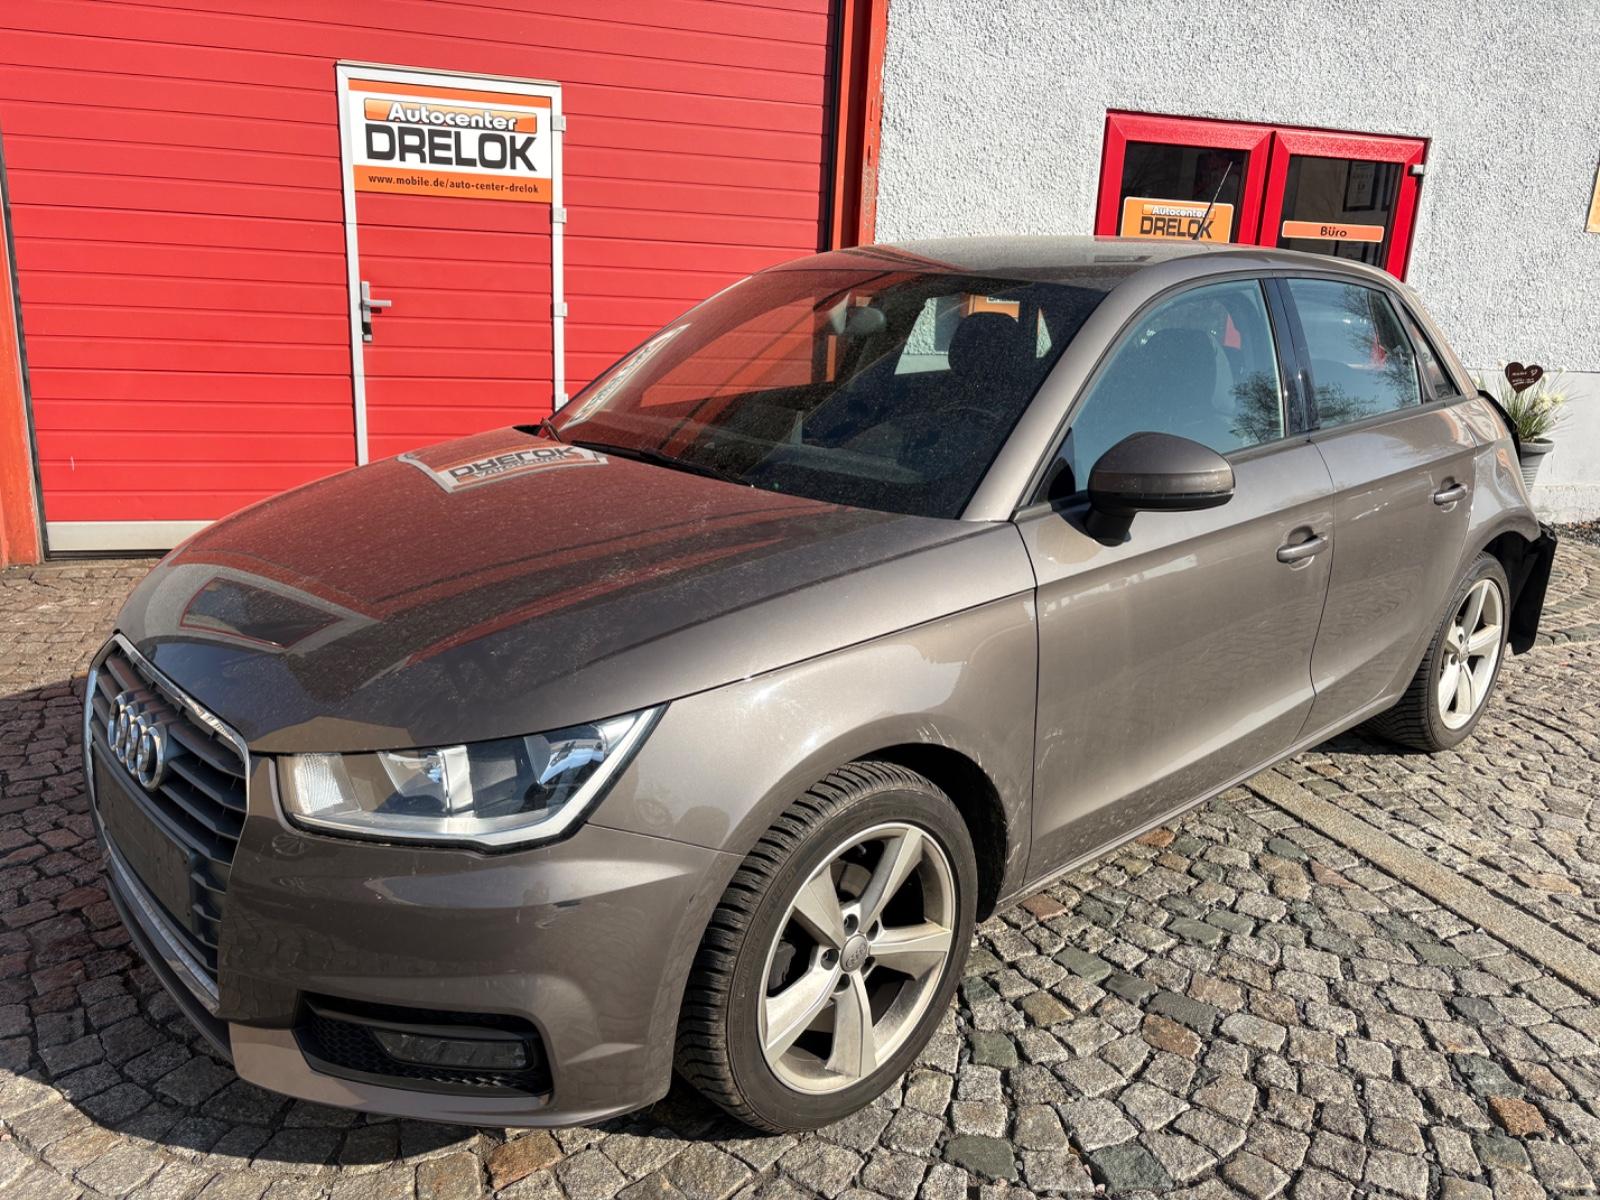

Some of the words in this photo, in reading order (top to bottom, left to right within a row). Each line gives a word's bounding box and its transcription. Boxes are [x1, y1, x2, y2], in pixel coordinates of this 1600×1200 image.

[388, 102, 518, 131] Autocenter
[365, 123, 537, 172] DRELOK
[368, 174, 539, 193] www.mobile.de/auto-center-drelok
[1140, 216, 1214, 239] DRELOK
[1320, 225, 1347, 238] Büro
